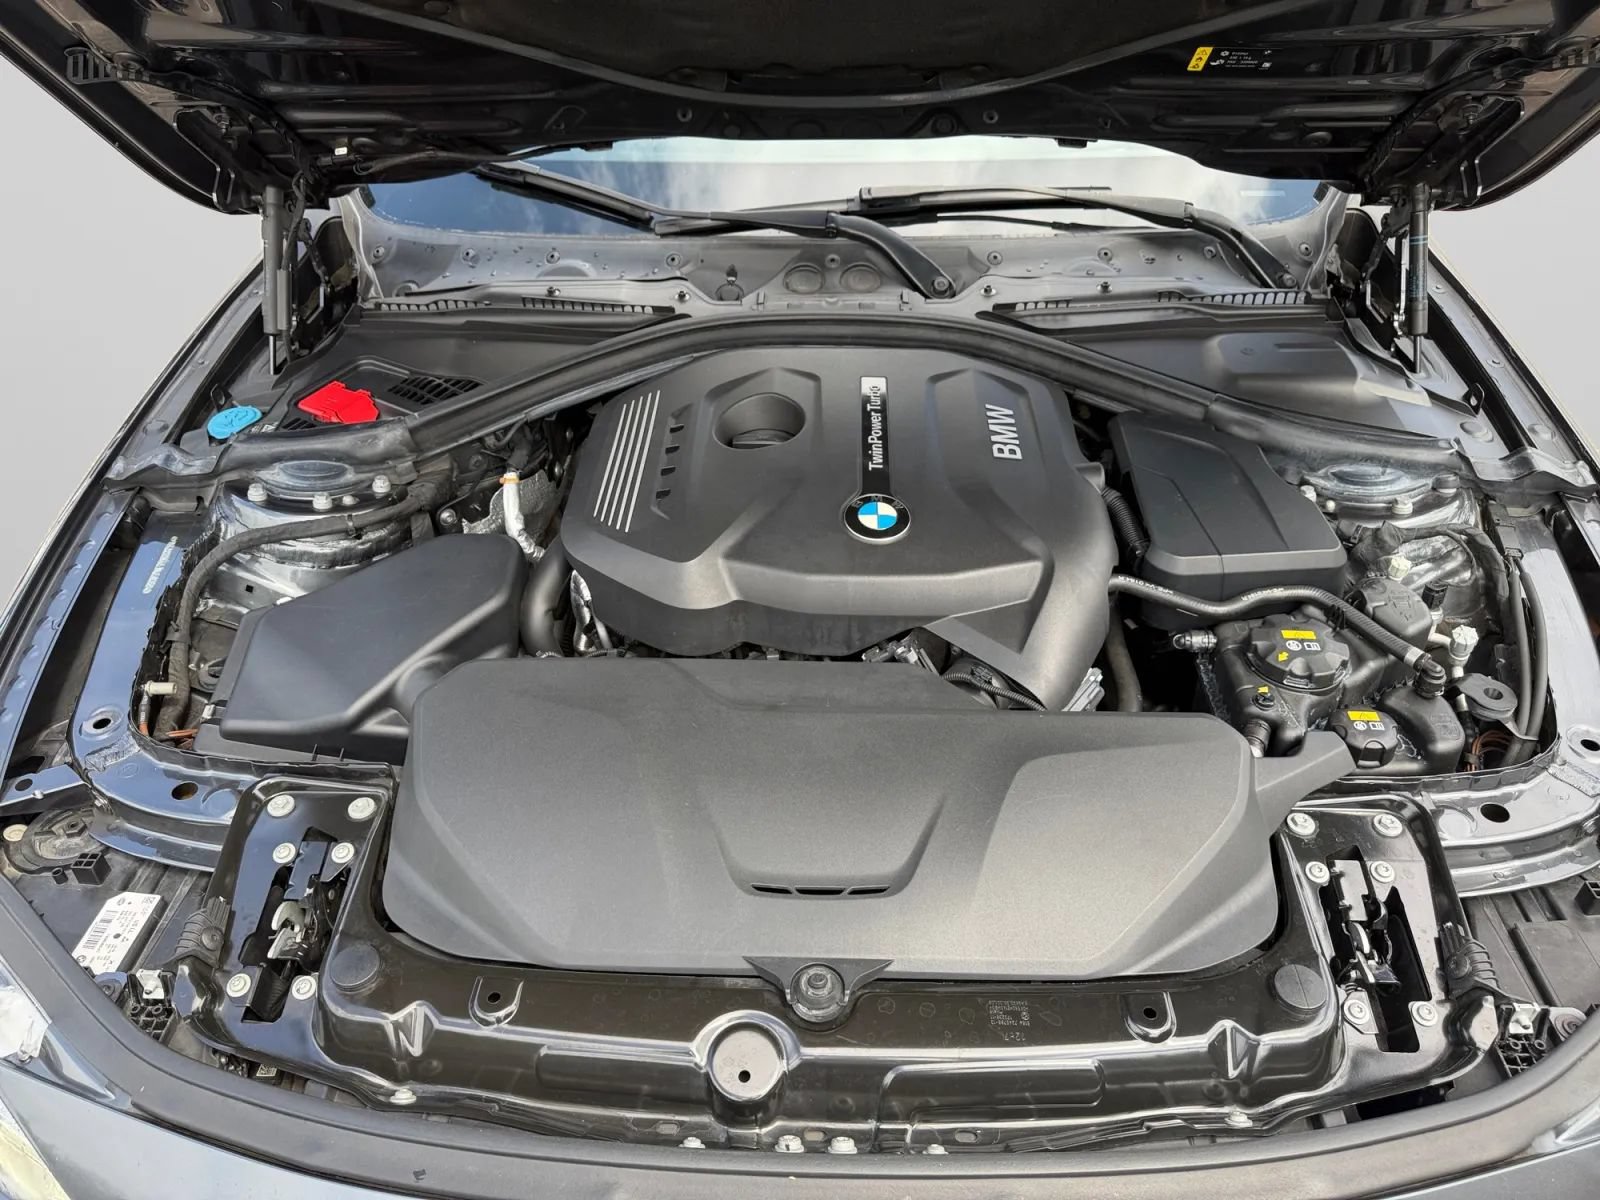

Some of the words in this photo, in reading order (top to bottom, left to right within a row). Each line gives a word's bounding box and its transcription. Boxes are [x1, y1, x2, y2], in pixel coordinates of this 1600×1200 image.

[867, 385, 881, 411] Turbo
[868, 412, 883, 471] TwinPower
[985, 404, 1023, 460] BMW
